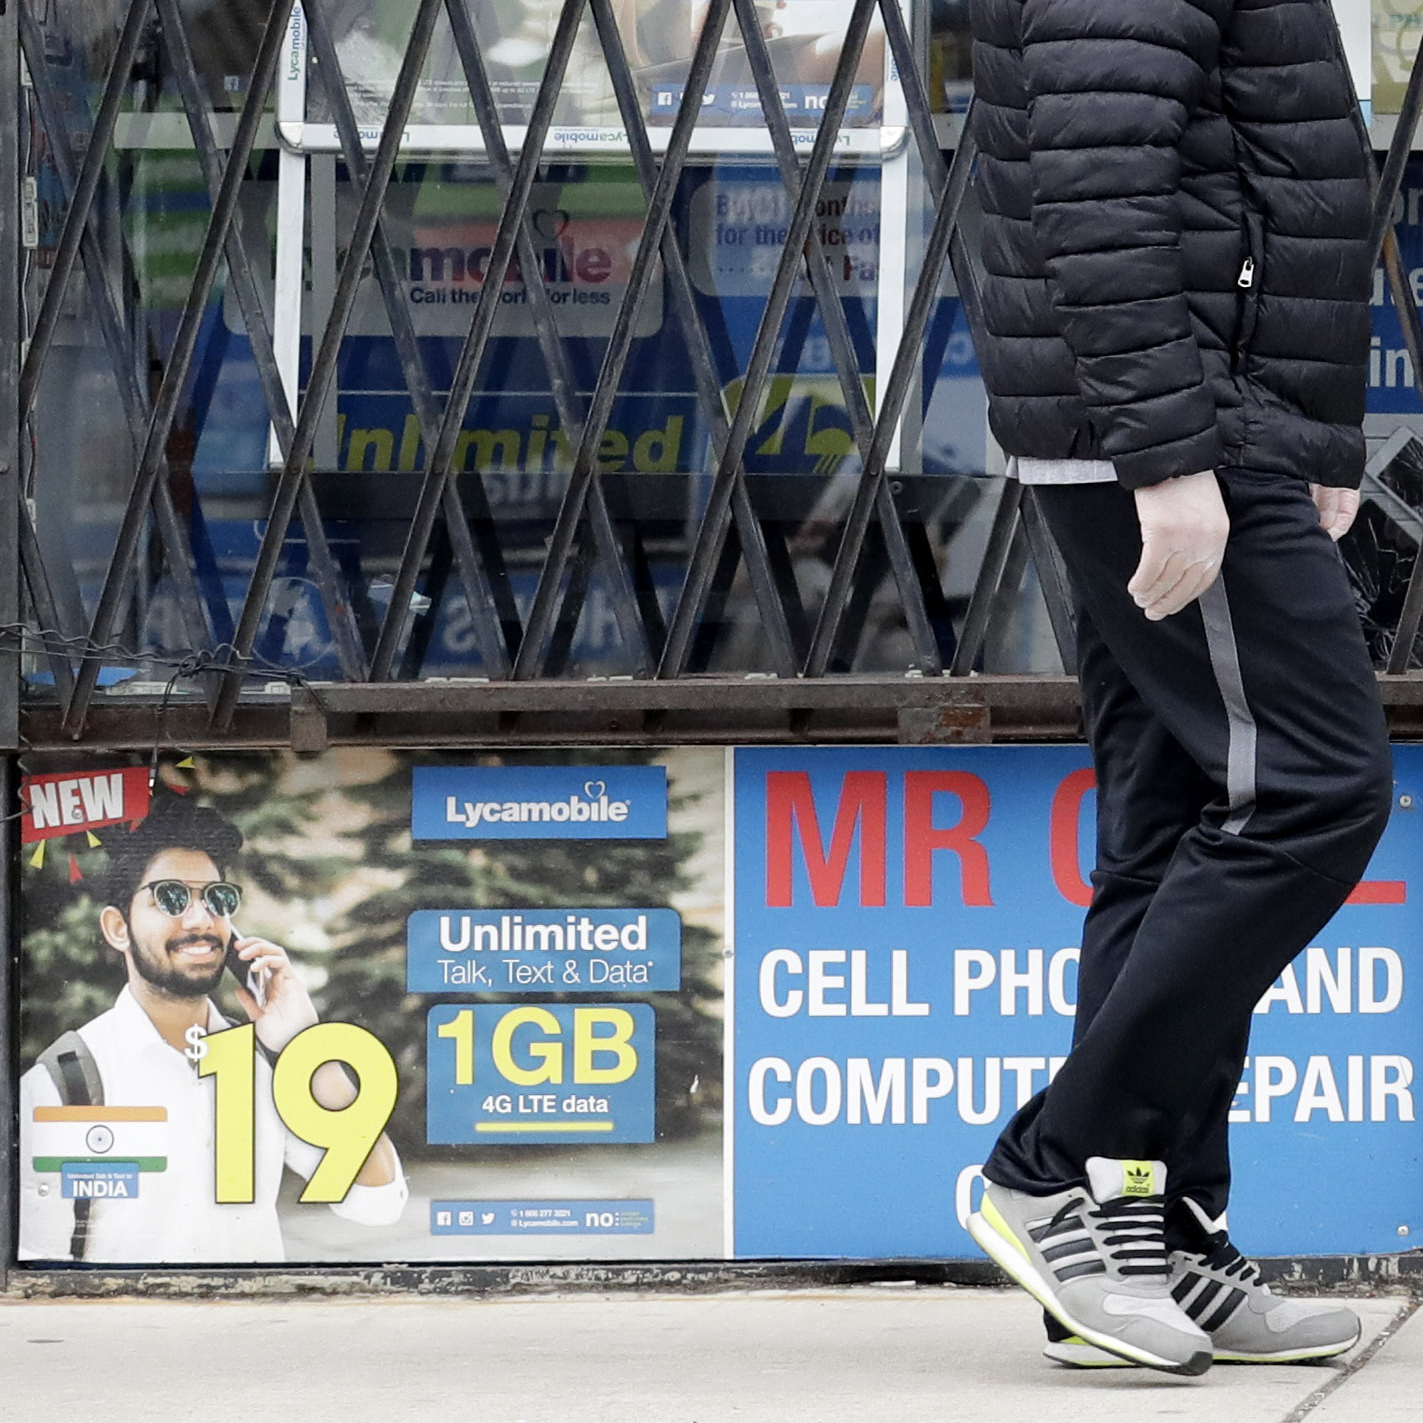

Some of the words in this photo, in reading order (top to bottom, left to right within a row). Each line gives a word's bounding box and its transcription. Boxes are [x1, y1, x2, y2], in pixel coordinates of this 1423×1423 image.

[28, 779, 125, 830] NEW
[446, 789, 630, 828] Lycamobile
[765, 770, 995, 909] MR
[438, 914, 647, 952] Unlimited
[437, 960, 494, 988] Talk,
[501, 961, 556, 985] Text
[562, 961, 581, 985] &
[758, 947, 931, 1018] CELL
[436, 1005, 639, 1088] 1GB
[184, 1021, 399, 1204] $19
[482, 1095, 513, 1114] 4G
[517, 1095, 557, 1114] LTE
[562, 1094, 609, 1114] data
[72, 1179, 129, 1198] INDIA
